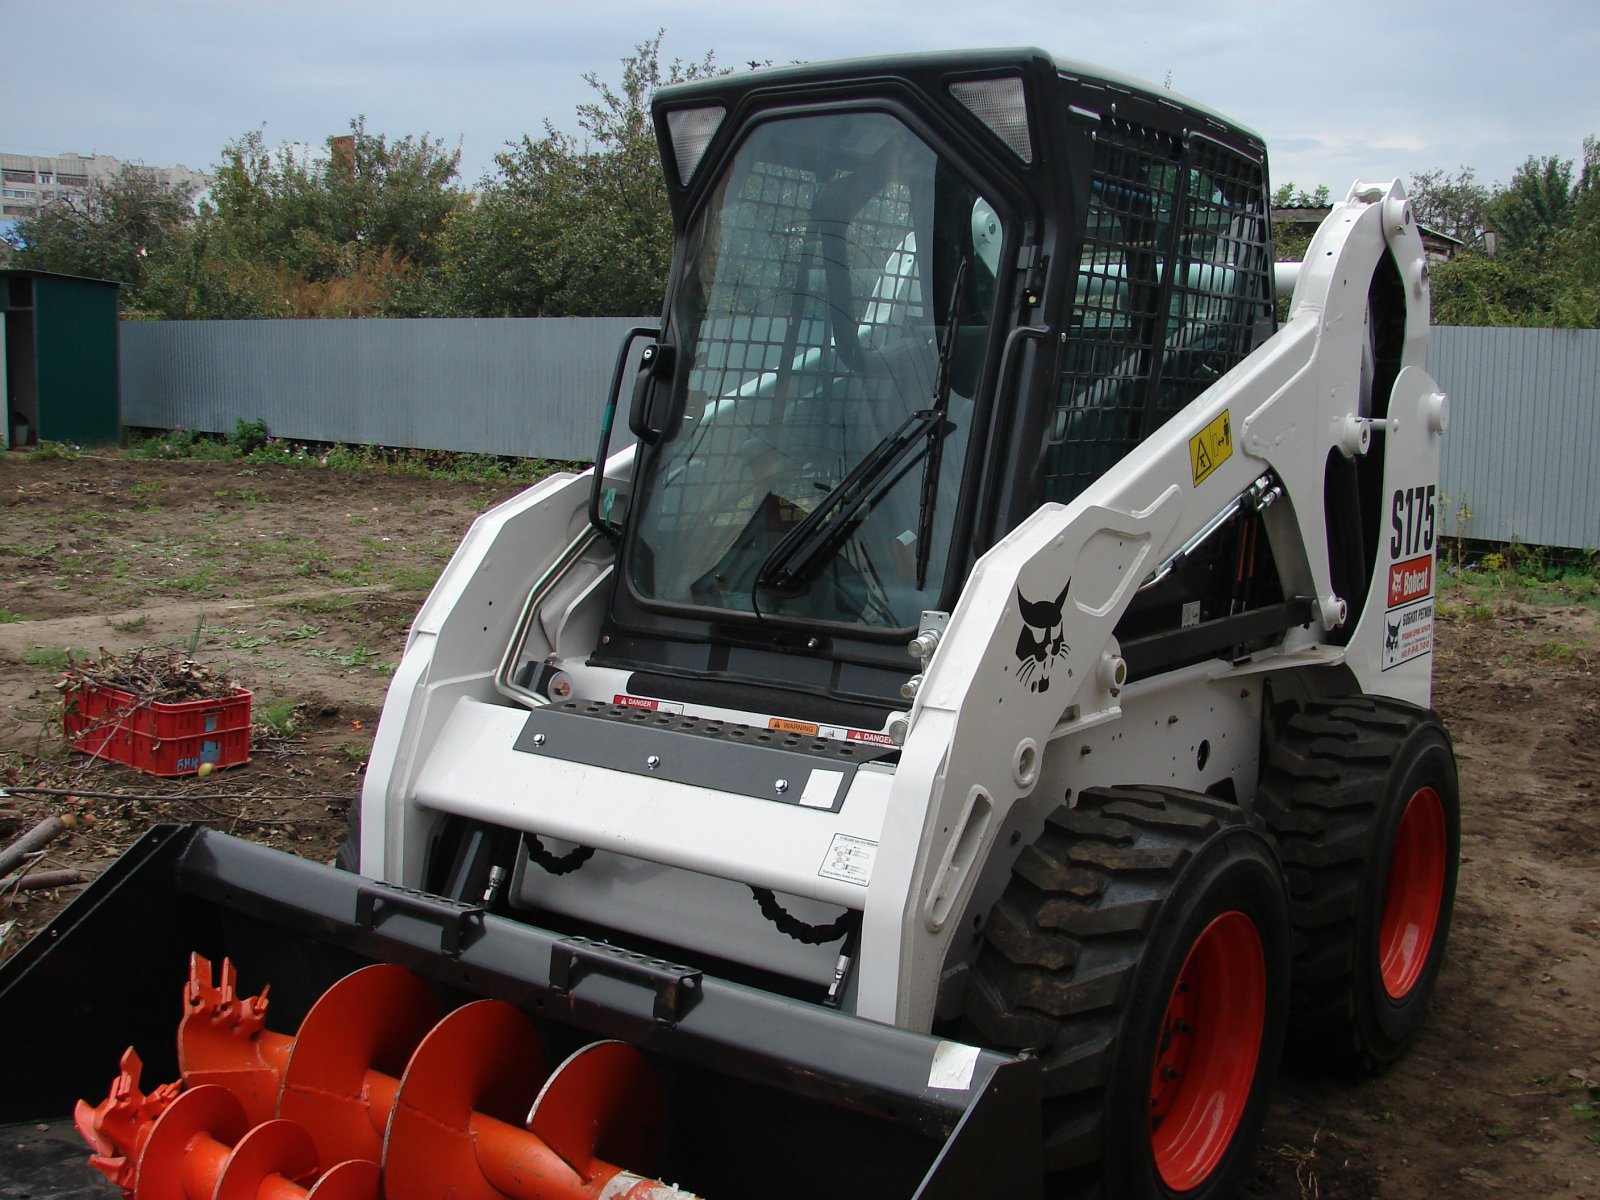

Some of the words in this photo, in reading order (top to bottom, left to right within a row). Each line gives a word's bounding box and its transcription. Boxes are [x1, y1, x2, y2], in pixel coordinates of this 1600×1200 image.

[1391, 485, 1435, 559] S175
[1404, 566, 1428, 596] Bobcat
[628, 698, 652, 708] DANGER
[783, 721, 814, 733] WARNING
